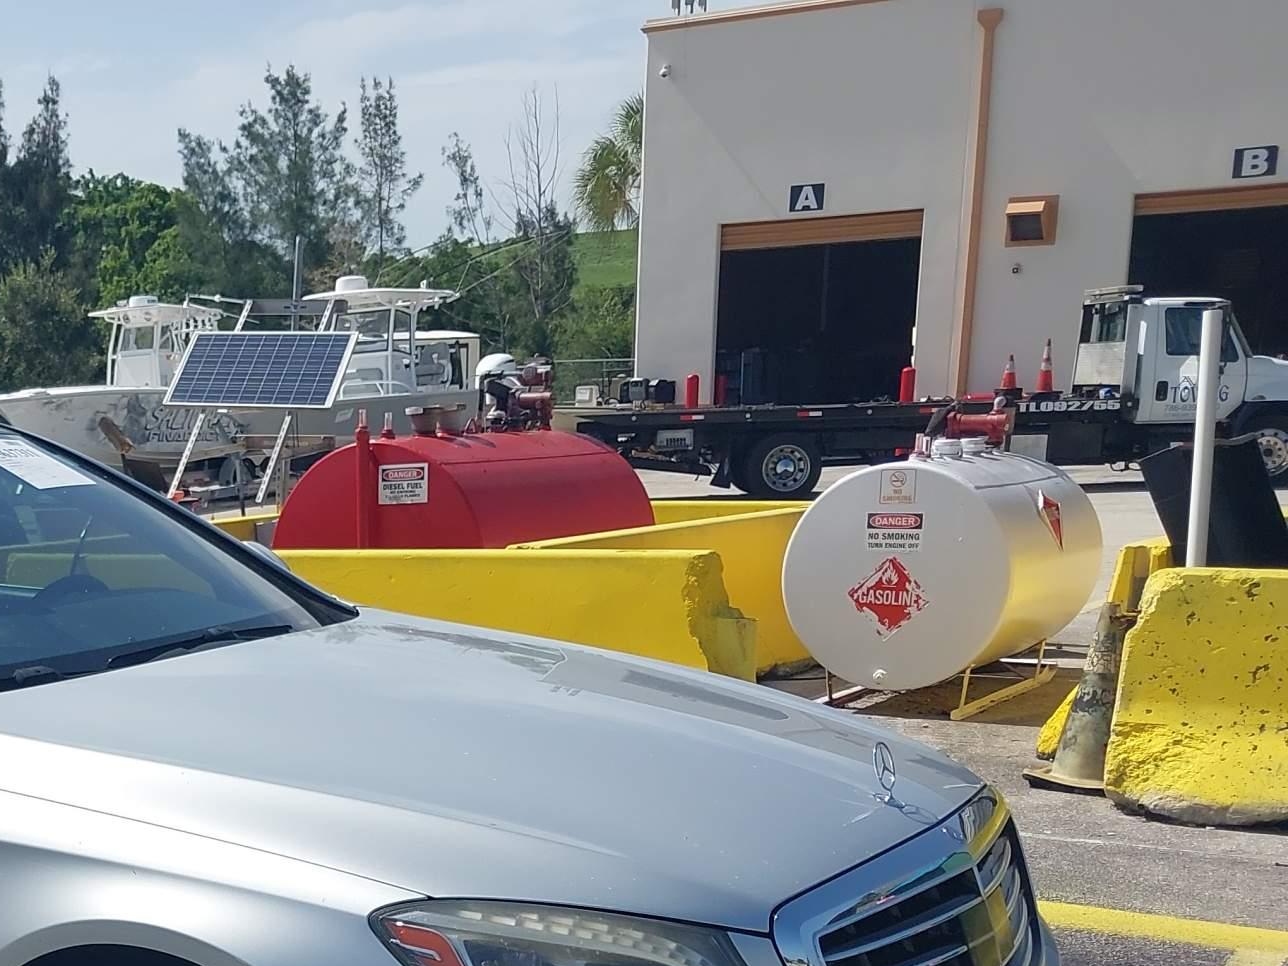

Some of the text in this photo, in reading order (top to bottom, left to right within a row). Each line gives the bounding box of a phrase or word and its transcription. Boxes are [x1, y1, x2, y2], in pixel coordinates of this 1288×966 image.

[1241, 149, 1269, 177] B
[794, 186, 818, 211] A
[1171, 385, 1230, 403] TOG
[389, 471, 417, 479] DANGER
[383, 482, 423, 491] DIESEL FUEL
[875, 517, 915, 526] DANGER
[868, 532, 920, 541] NO SMOKING
